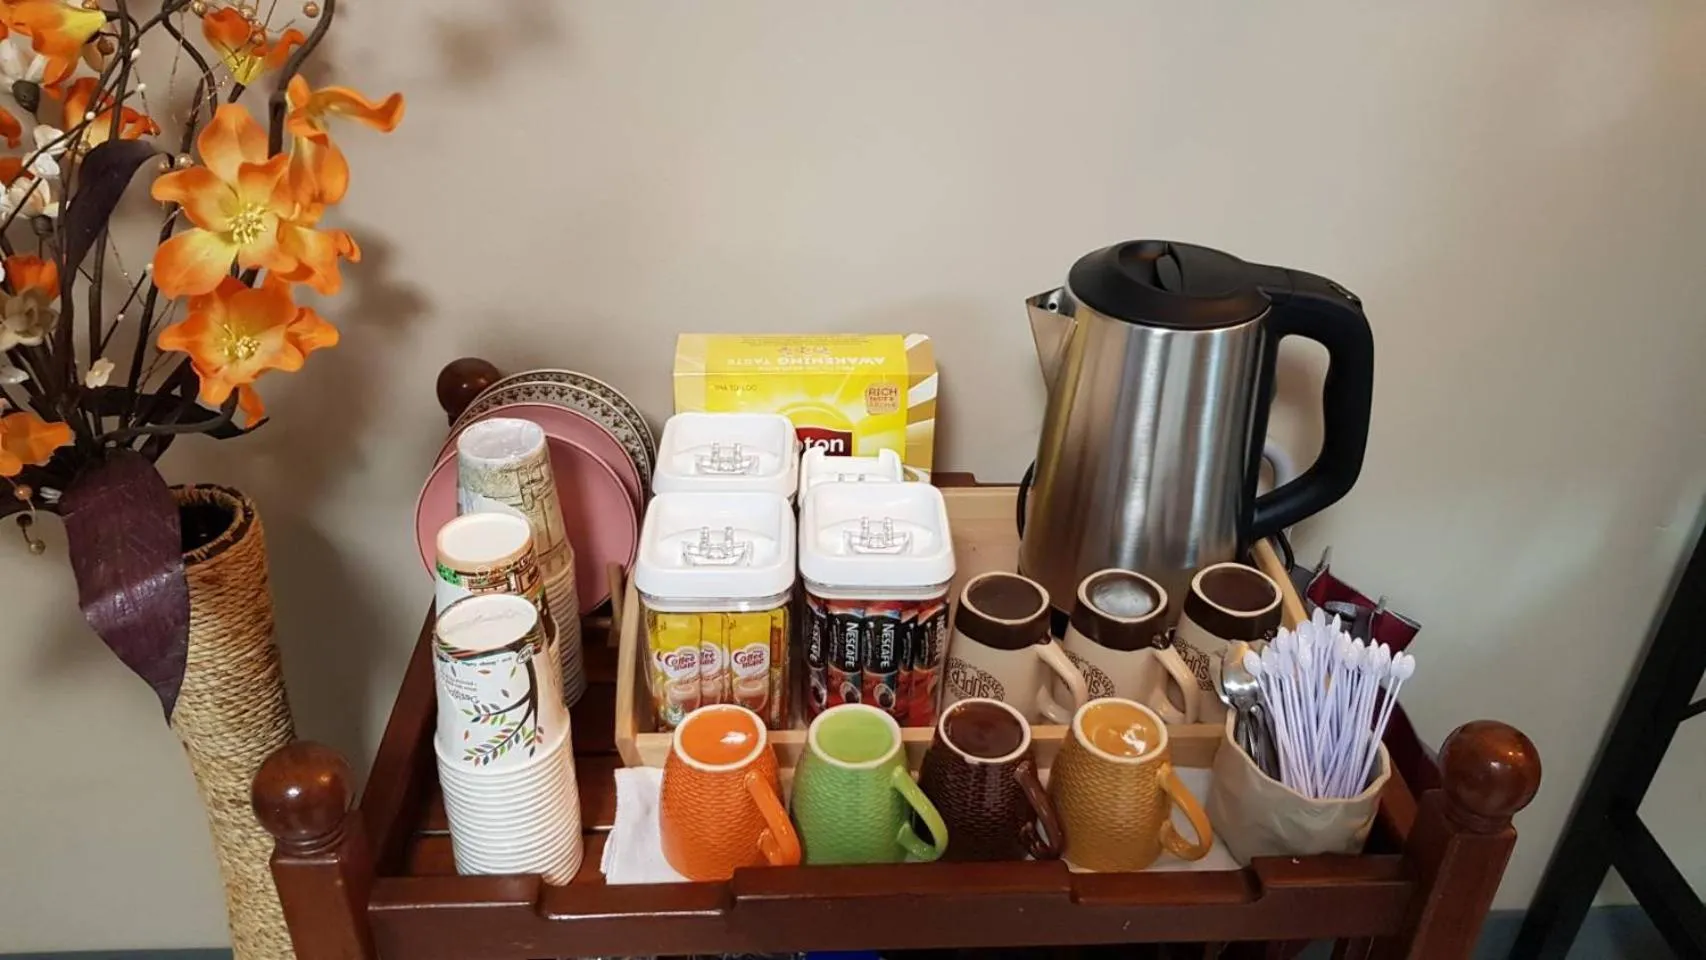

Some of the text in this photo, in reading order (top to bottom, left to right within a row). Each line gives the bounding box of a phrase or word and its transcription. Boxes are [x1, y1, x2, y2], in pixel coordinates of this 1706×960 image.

[777, 356, 886, 366] AWAKENING
[868, 387, 897, 397] RICH
[803, 436, 844, 453] ton
[733, 650, 764, 665] Coffee
